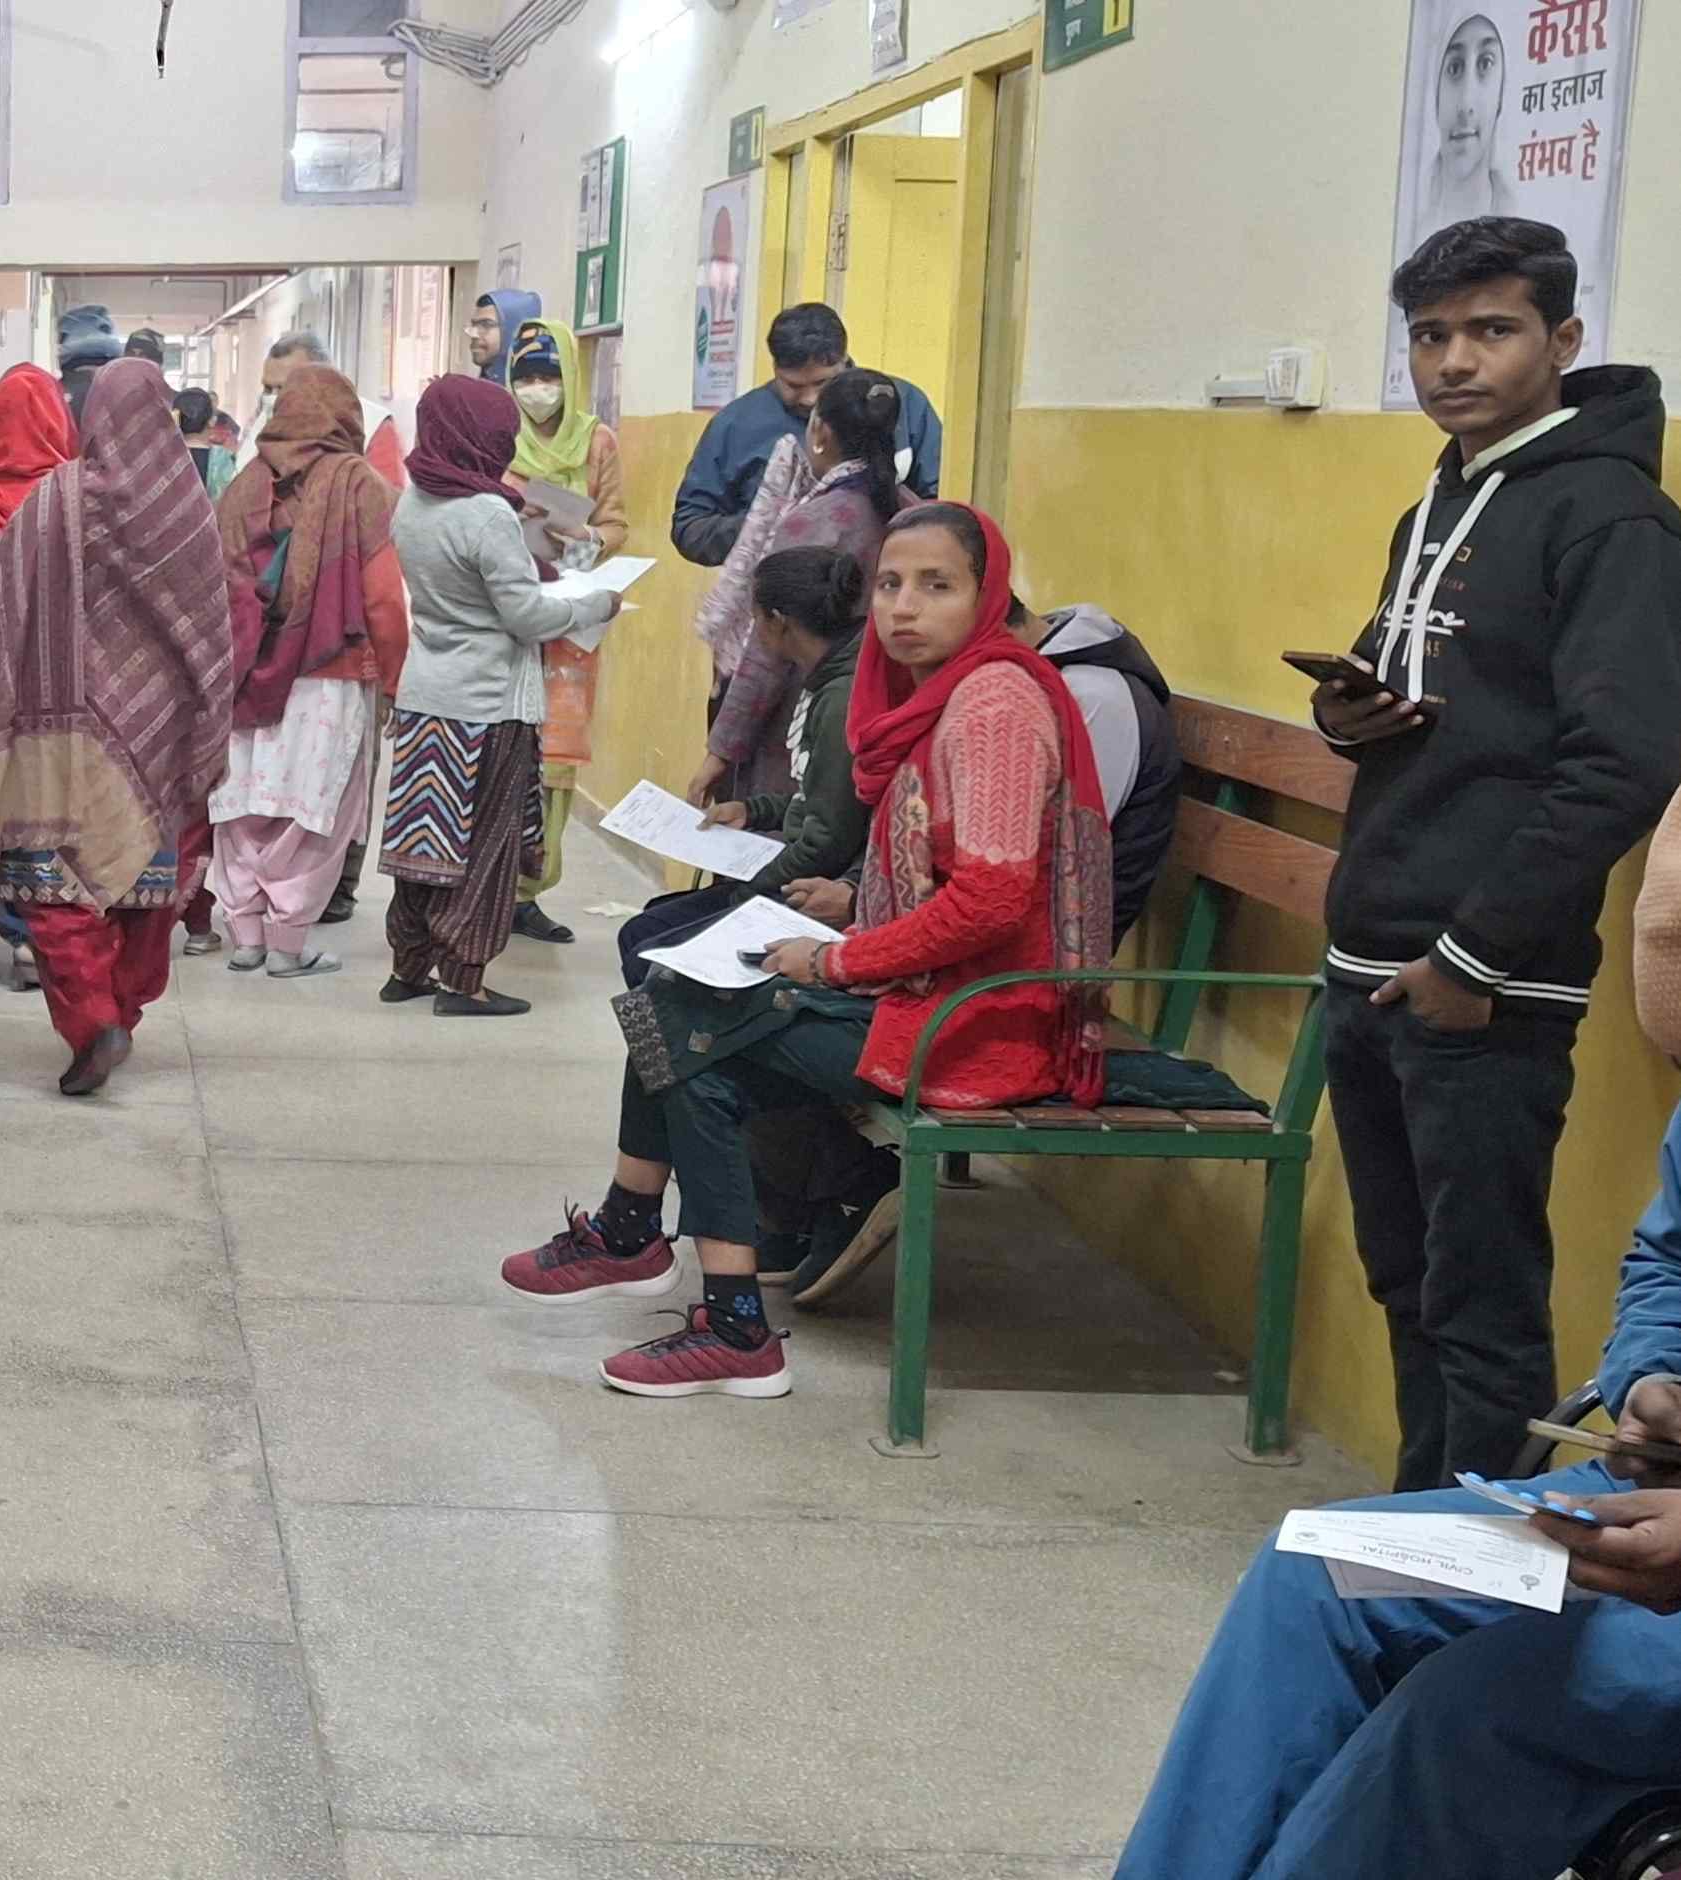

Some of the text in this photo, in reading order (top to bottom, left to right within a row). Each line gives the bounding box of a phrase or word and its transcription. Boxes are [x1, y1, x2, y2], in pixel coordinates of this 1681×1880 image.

[1522, 69, 1607, 114] का इलाज
[1518, 118, 1600, 181] संभव है
[1360, 1544, 1474, 1576] CIVIL HOSPITAL
